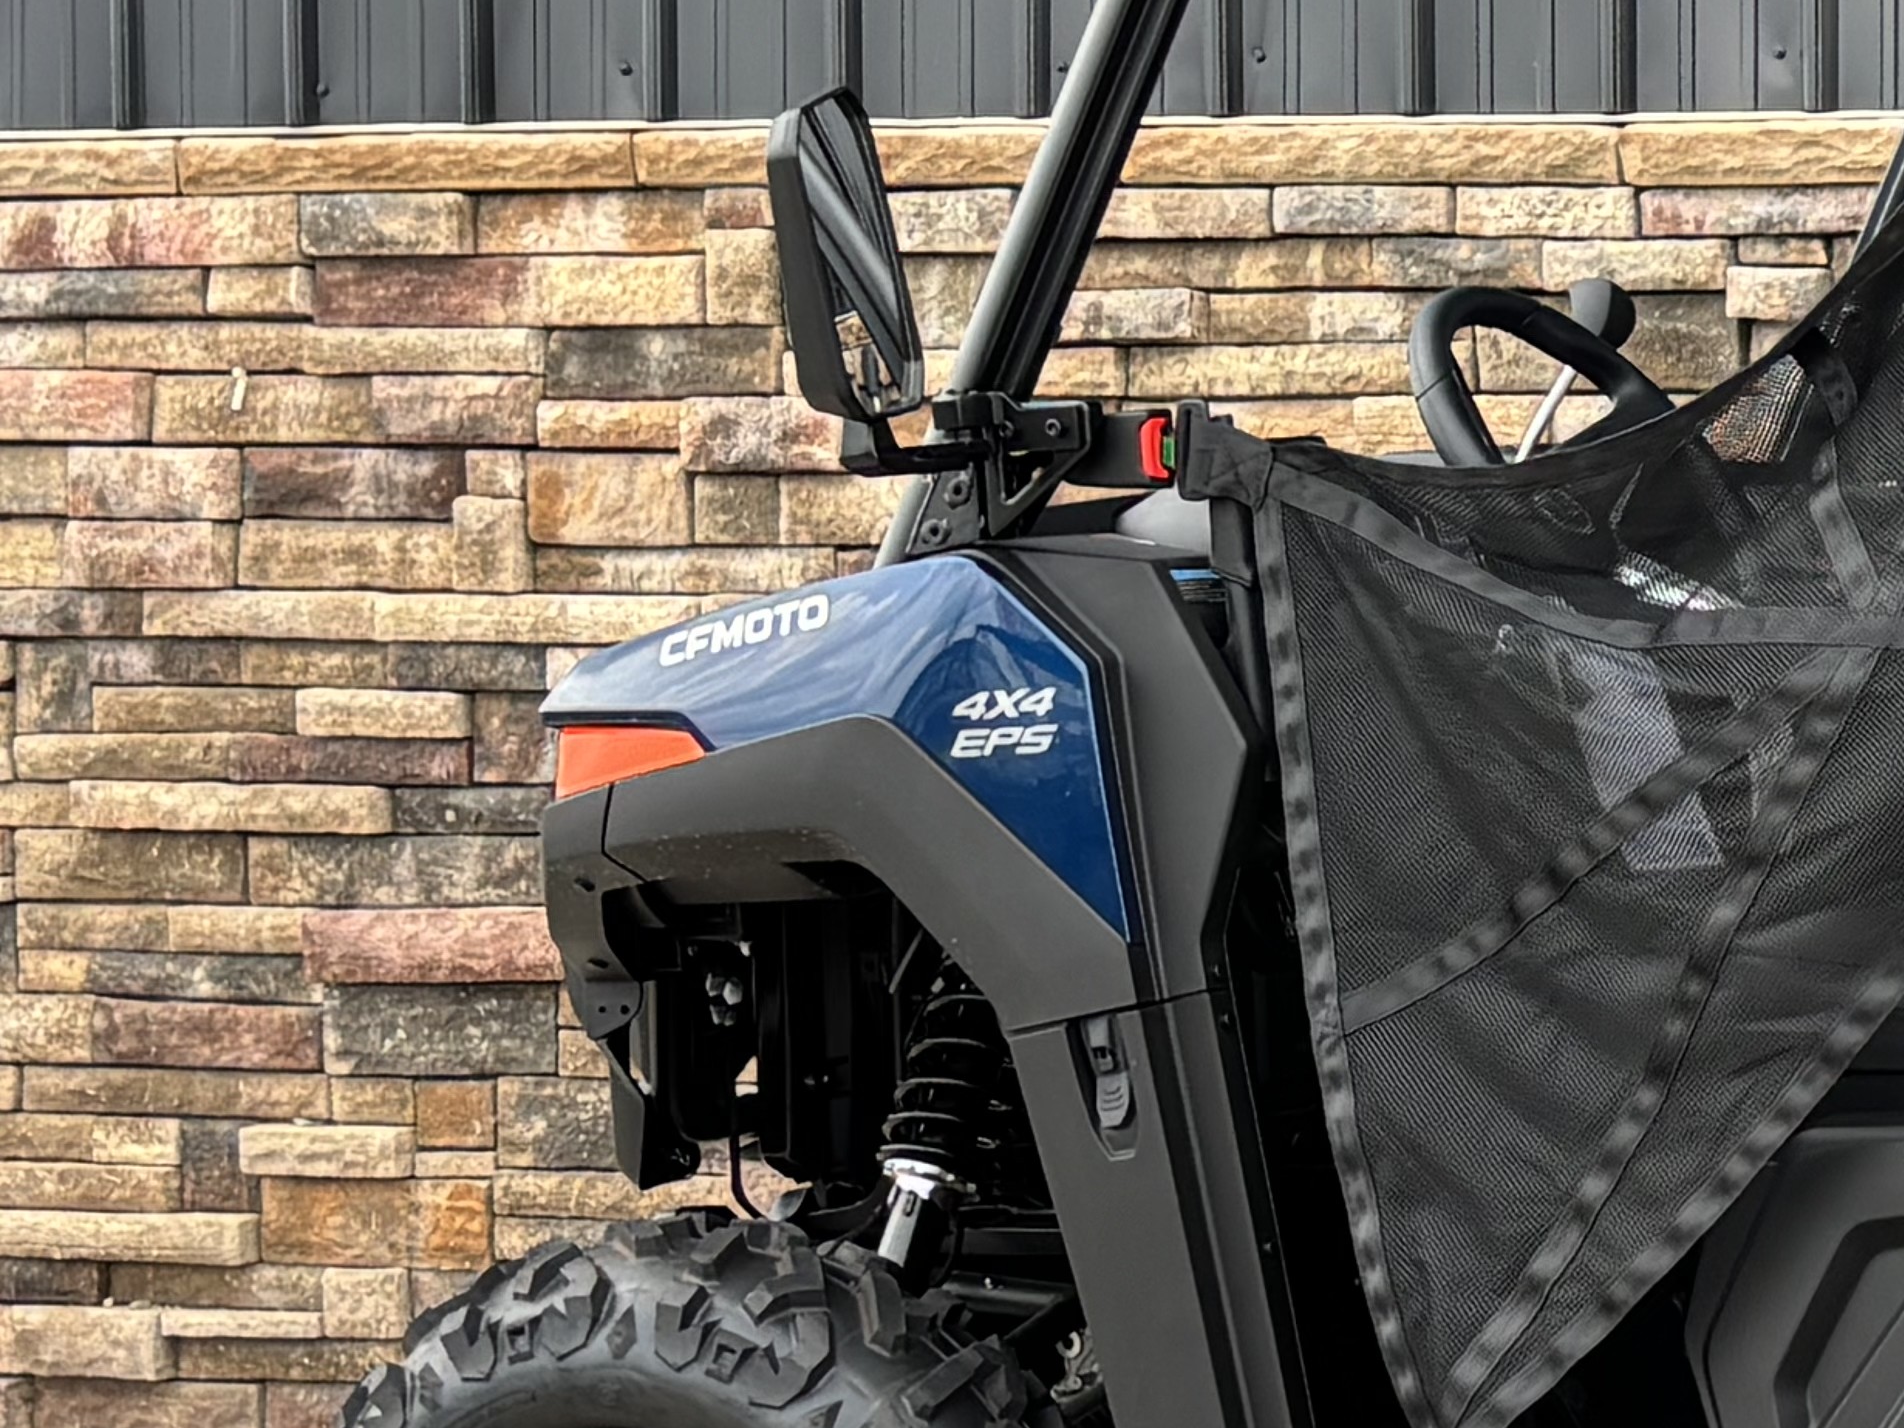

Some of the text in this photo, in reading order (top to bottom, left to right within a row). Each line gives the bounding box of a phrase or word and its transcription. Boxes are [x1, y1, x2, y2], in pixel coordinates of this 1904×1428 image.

[659, 594, 829, 666] CFMOTO
[952, 687, 1056, 722] 4X4
[951, 725, 1058, 759] EPS
